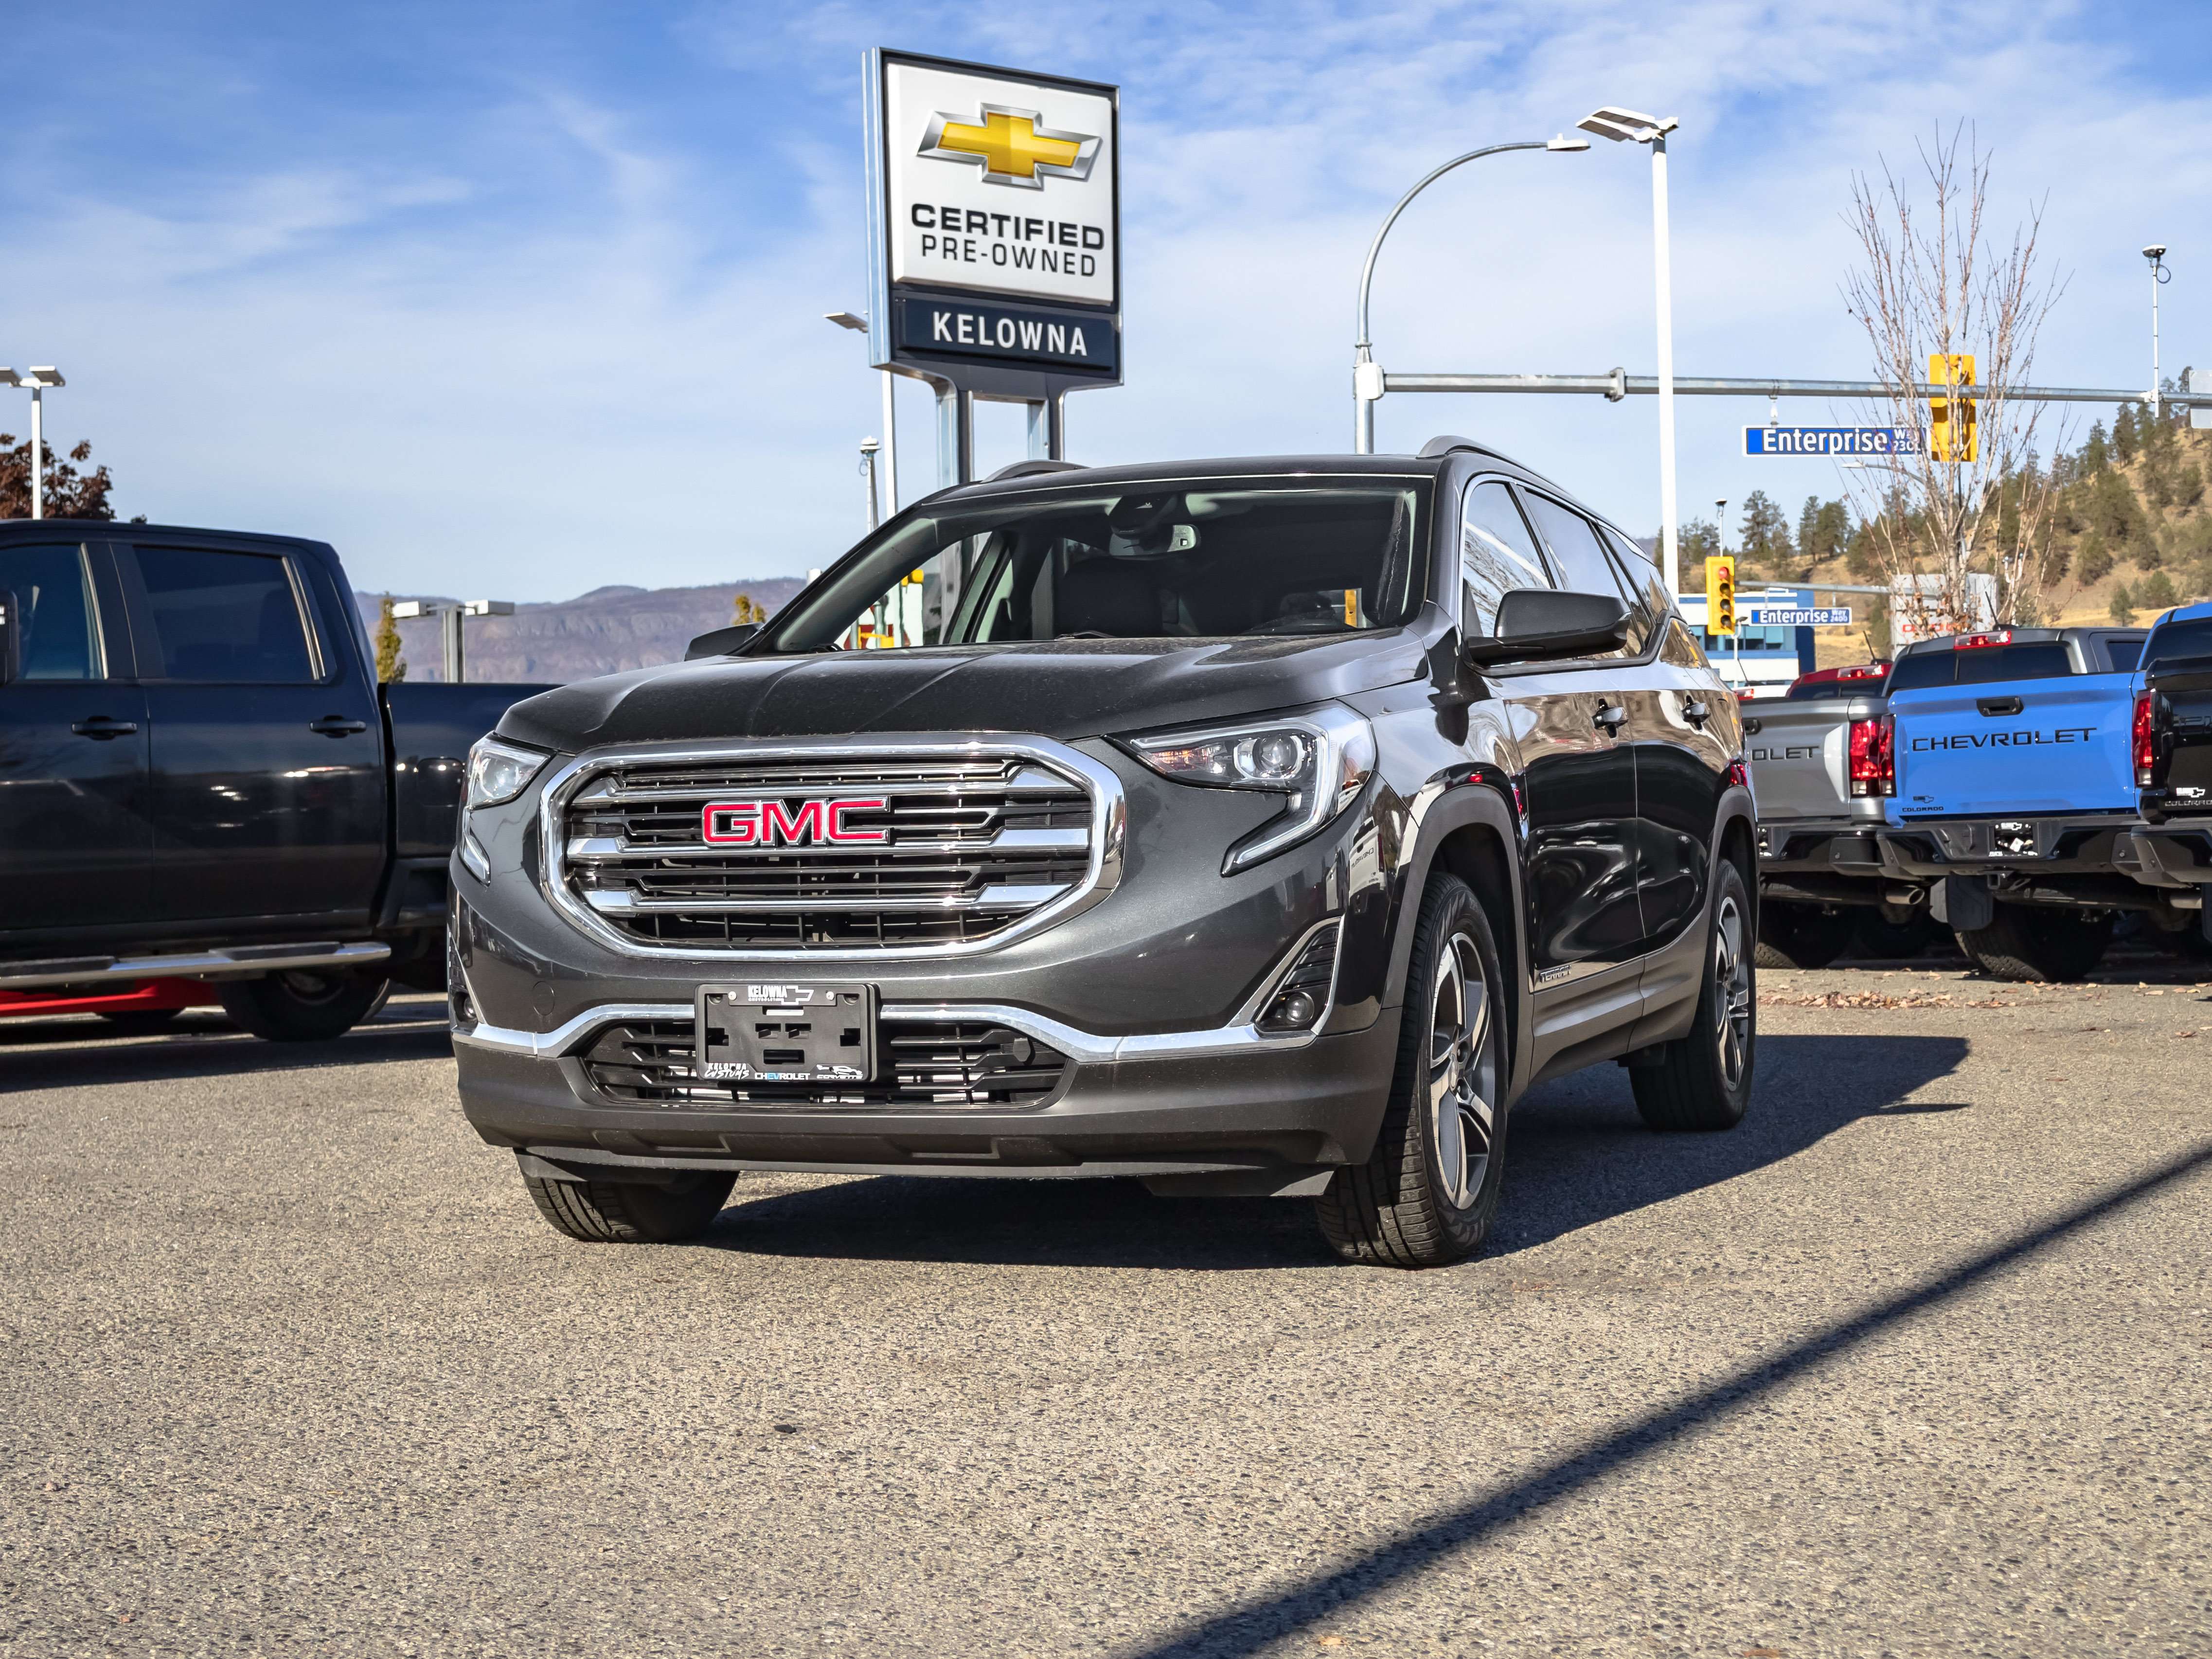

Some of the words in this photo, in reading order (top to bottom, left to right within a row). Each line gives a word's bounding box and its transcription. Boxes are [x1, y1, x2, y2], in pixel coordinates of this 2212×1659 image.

[911, 203, 1105, 250] CERTIFIED
[922, 234, 1096, 277] PRE-OWNED
[933, 311, 1088, 356] KELOWNA
[1763, 428, 1888, 455] Enterprise
[1760, 609, 1829, 624] Enterprise
[1912, 728, 2097, 751] CHEVROLET
[1751, 746, 1820, 761] OLET
[702, 795, 890, 847] GMC
[1540, 965, 1572, 983] TERRAIN
[748, 985, 787, 998] KELOWNA
[754, 1072, 811, 1080] CHEVROLET
